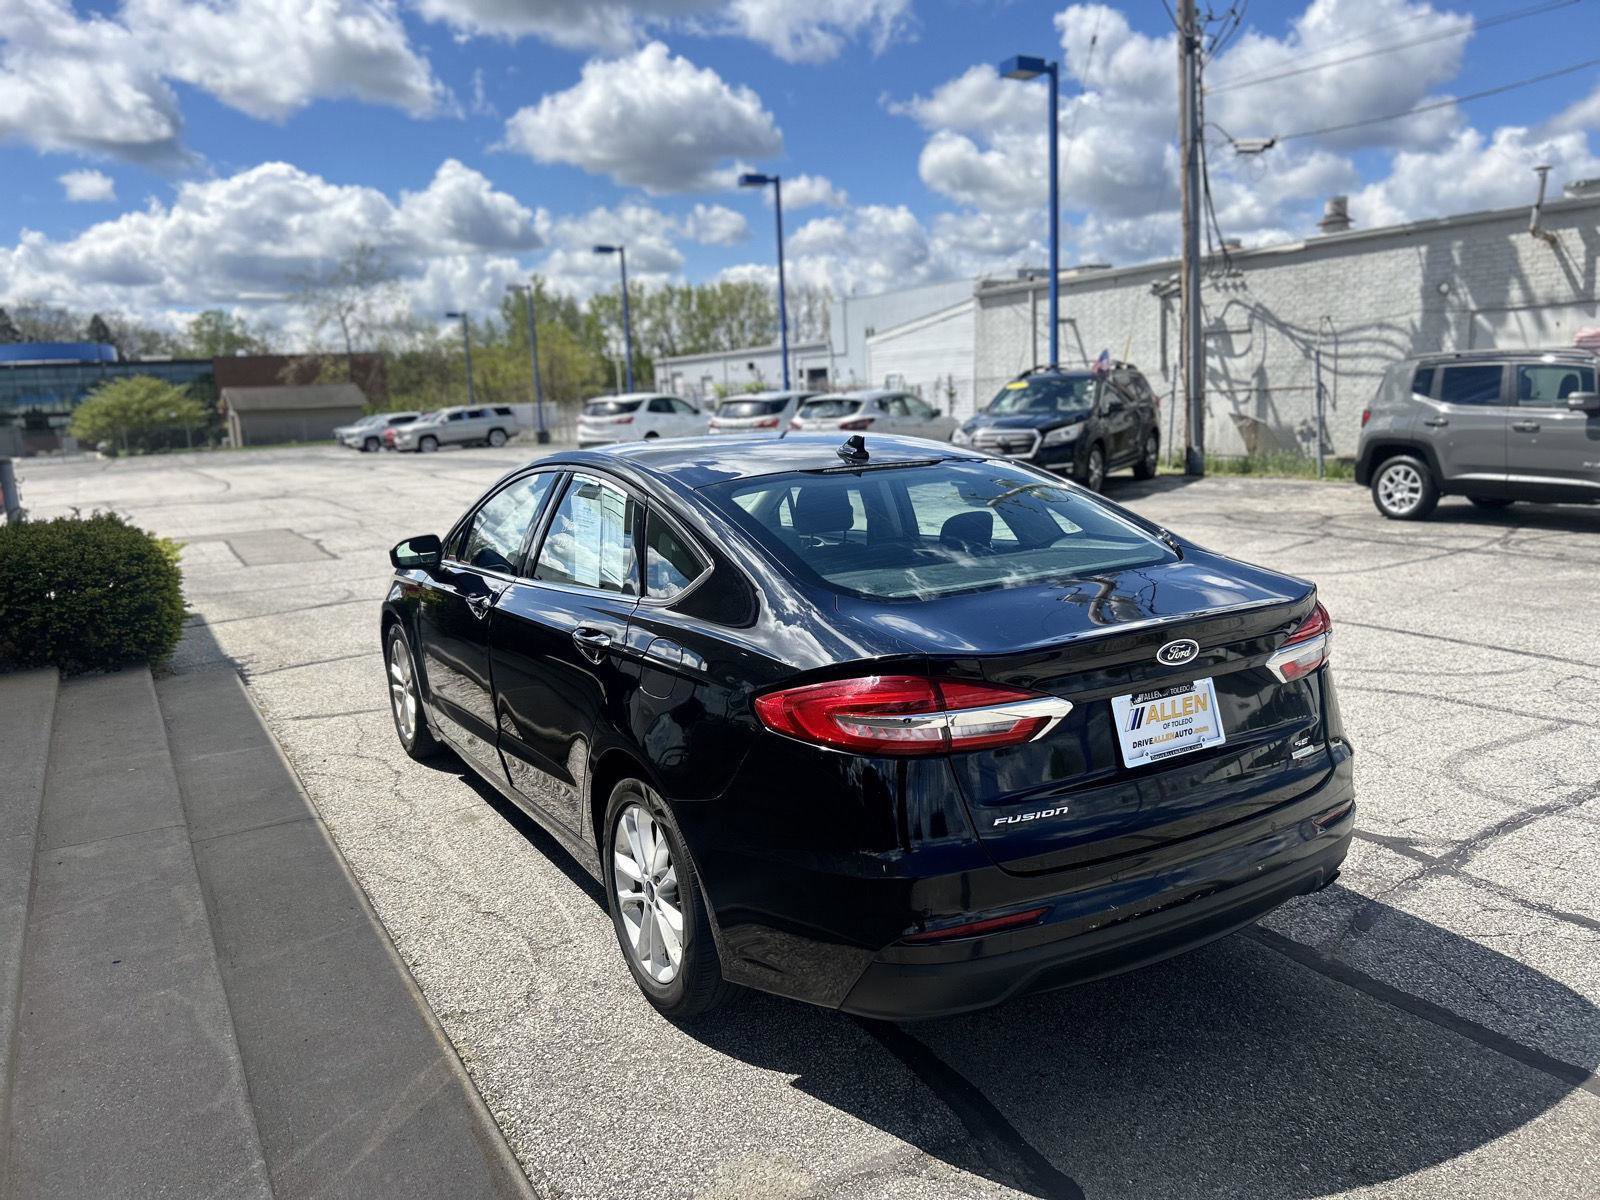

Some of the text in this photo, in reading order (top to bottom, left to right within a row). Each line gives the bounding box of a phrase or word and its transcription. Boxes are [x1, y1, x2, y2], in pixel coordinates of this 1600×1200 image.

[1167, 644, 1191, 660] Ford
[1146, 693, 1208, 725] ALLEN
[1163, 717, 1193, 730] OF TOLEDO
[1294, 737, 1309, 746] SE
[993, 806, 1069, 827] FUSION
